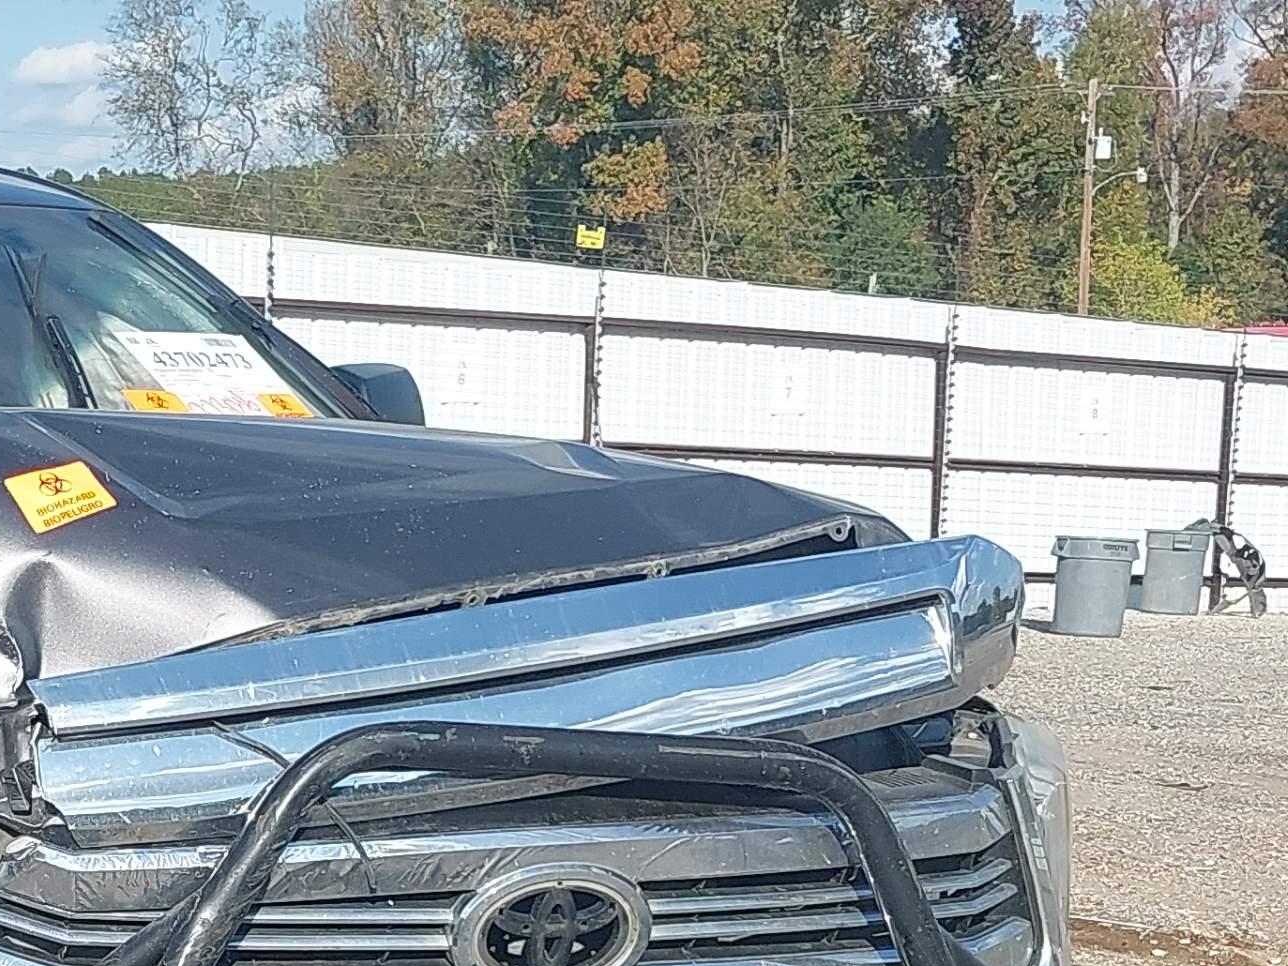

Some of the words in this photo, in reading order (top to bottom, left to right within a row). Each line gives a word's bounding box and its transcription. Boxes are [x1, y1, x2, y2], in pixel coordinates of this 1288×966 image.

[153, 351, 253, 369] 43702473
[36, 490, 97, 517] BIOHAZARD
[42, 500, 104, 528] BIOPELIGRO
